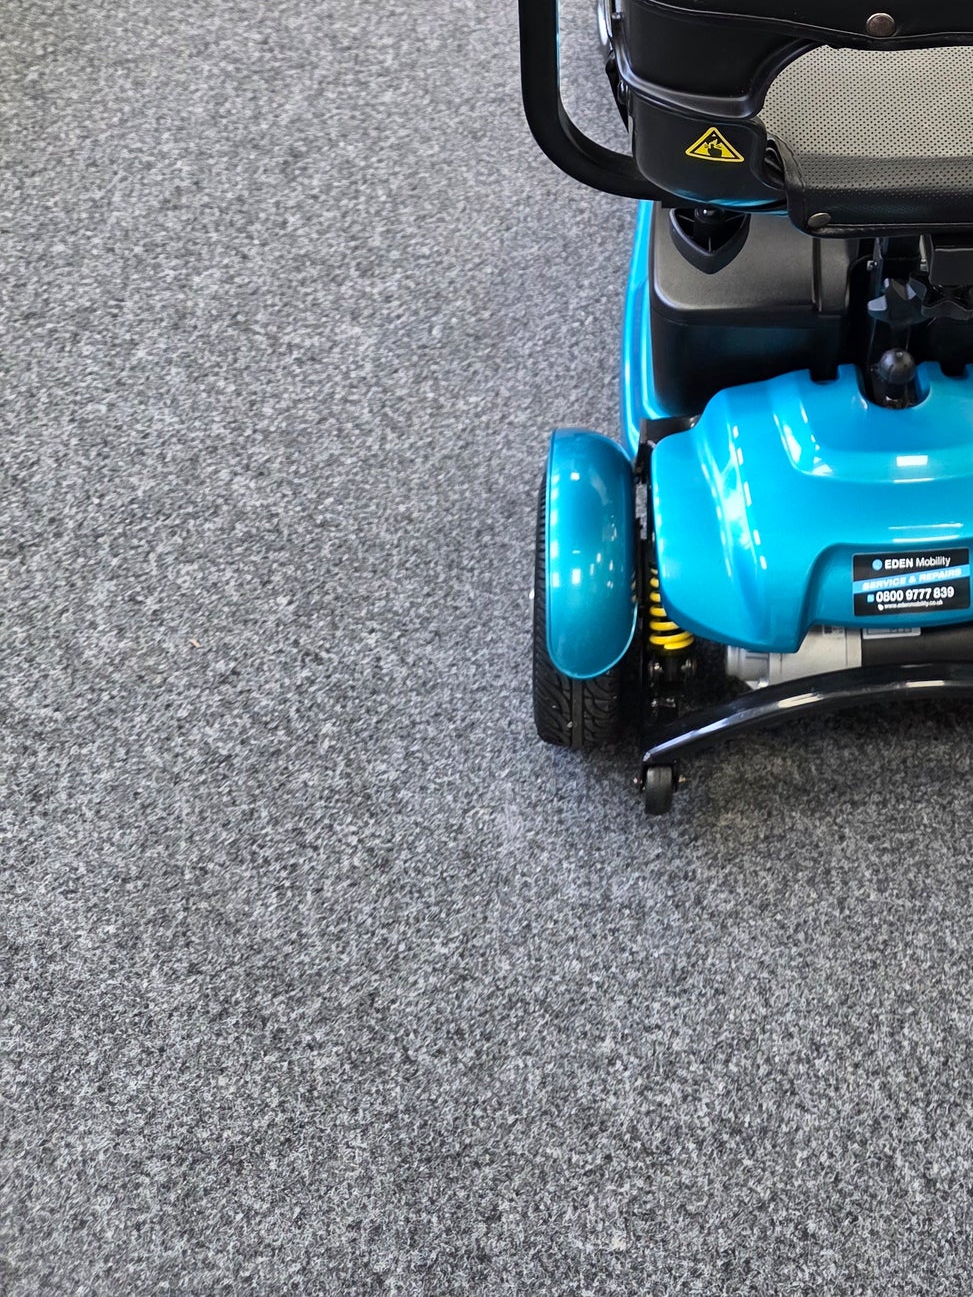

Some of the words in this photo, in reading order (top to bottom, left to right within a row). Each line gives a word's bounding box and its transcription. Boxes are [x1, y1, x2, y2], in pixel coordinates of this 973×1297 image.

[884, 558, 914, 570] EDEN
[915, 556, 951, 568] Mobility
[862, 575, 907, 591] SERVICE
[908, 575, 917, 585] &
[919, 568, 963, 582] REPAIRS
[875, 589, 904, 603] 0800
[905, 587, 932, 601] 9777
[933, 585, 955, 599] 839
